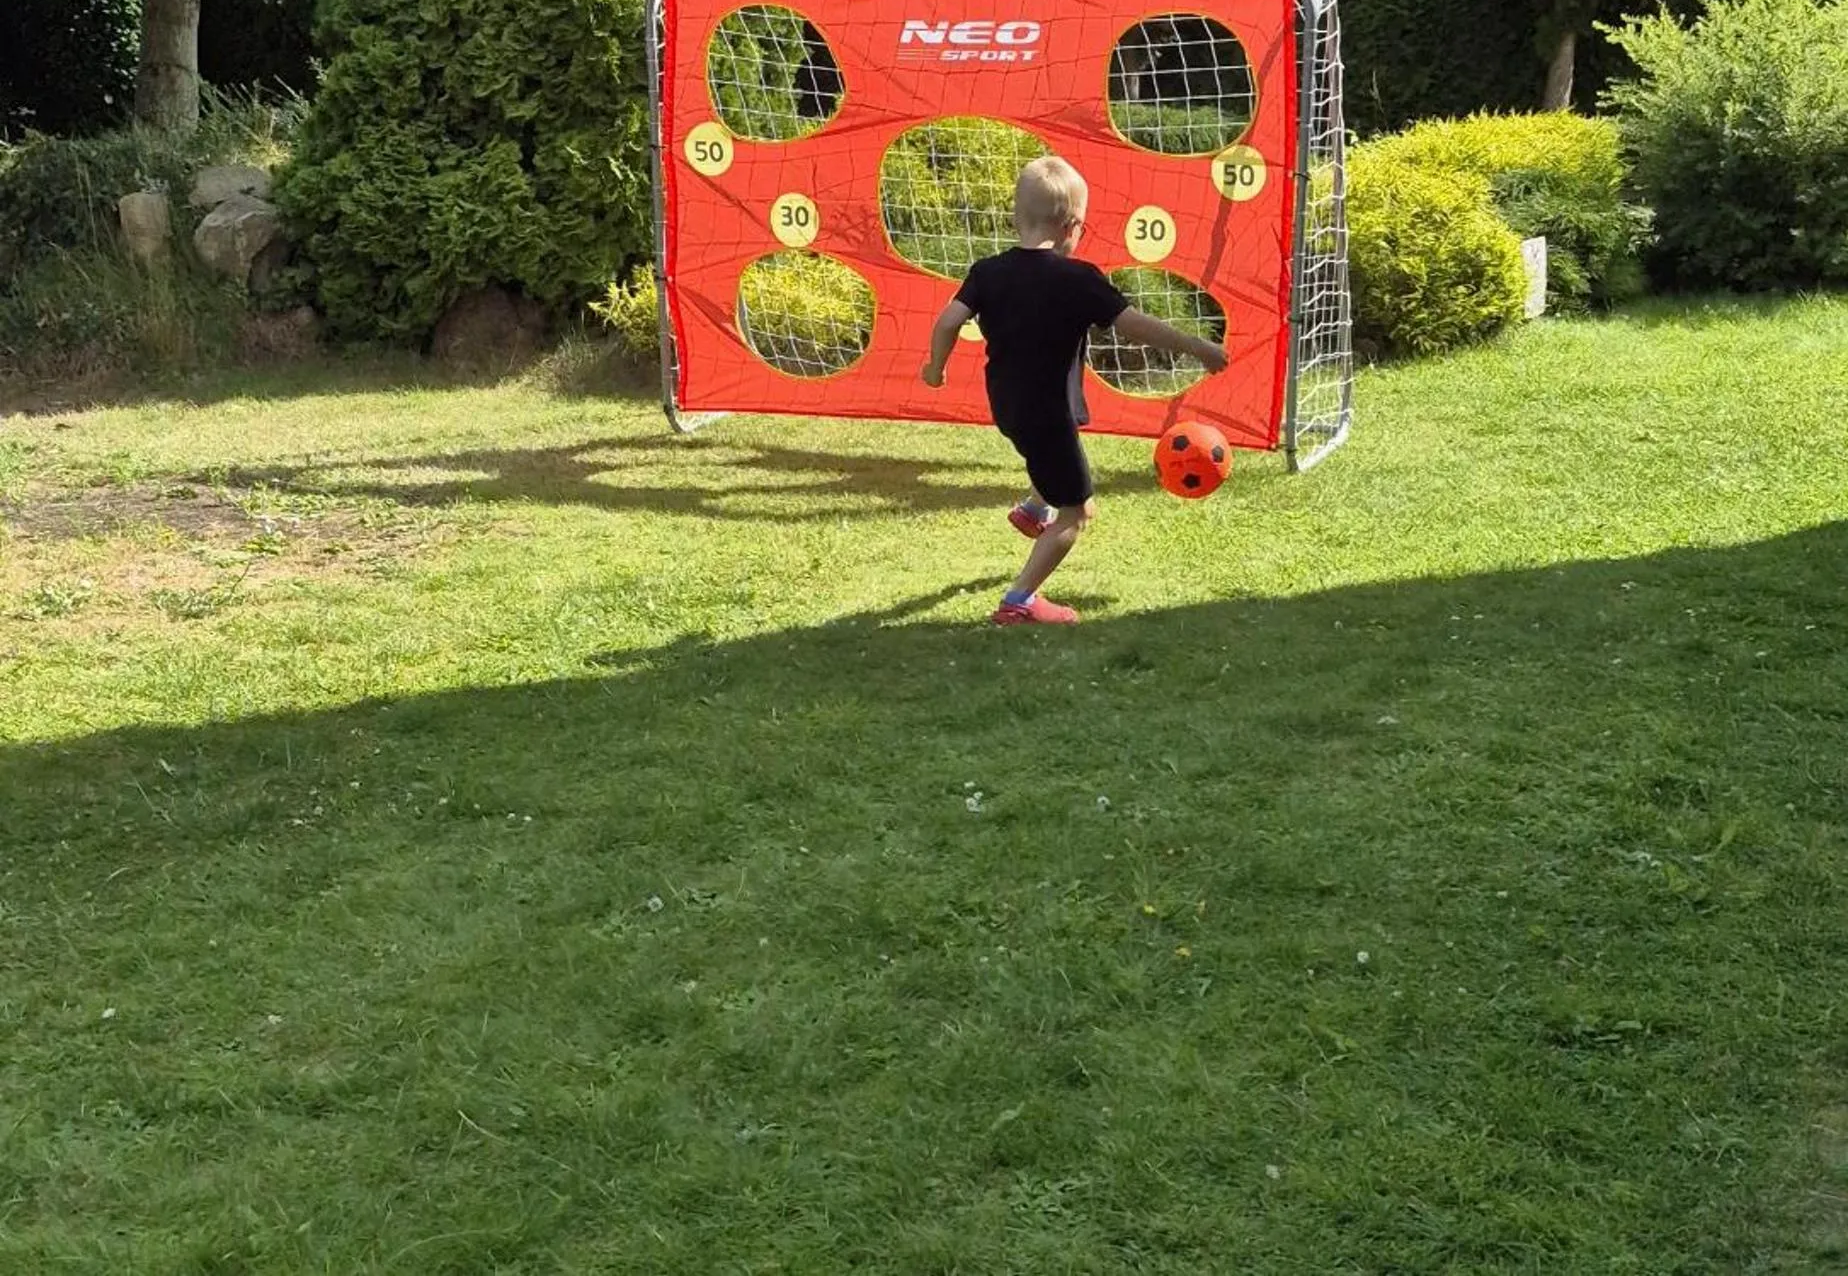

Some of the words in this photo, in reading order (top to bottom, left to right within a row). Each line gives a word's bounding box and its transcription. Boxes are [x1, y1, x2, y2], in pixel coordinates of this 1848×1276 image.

[900, 20, 1041, 44] NEO
[939, 50, 1040, 61] SPORT
[695, 141, 724, 162] 50
[1223, 164, 1255, 186] 50
[780, 206, 809, 227] 30
[1134, 219, 1165, 241] 30
